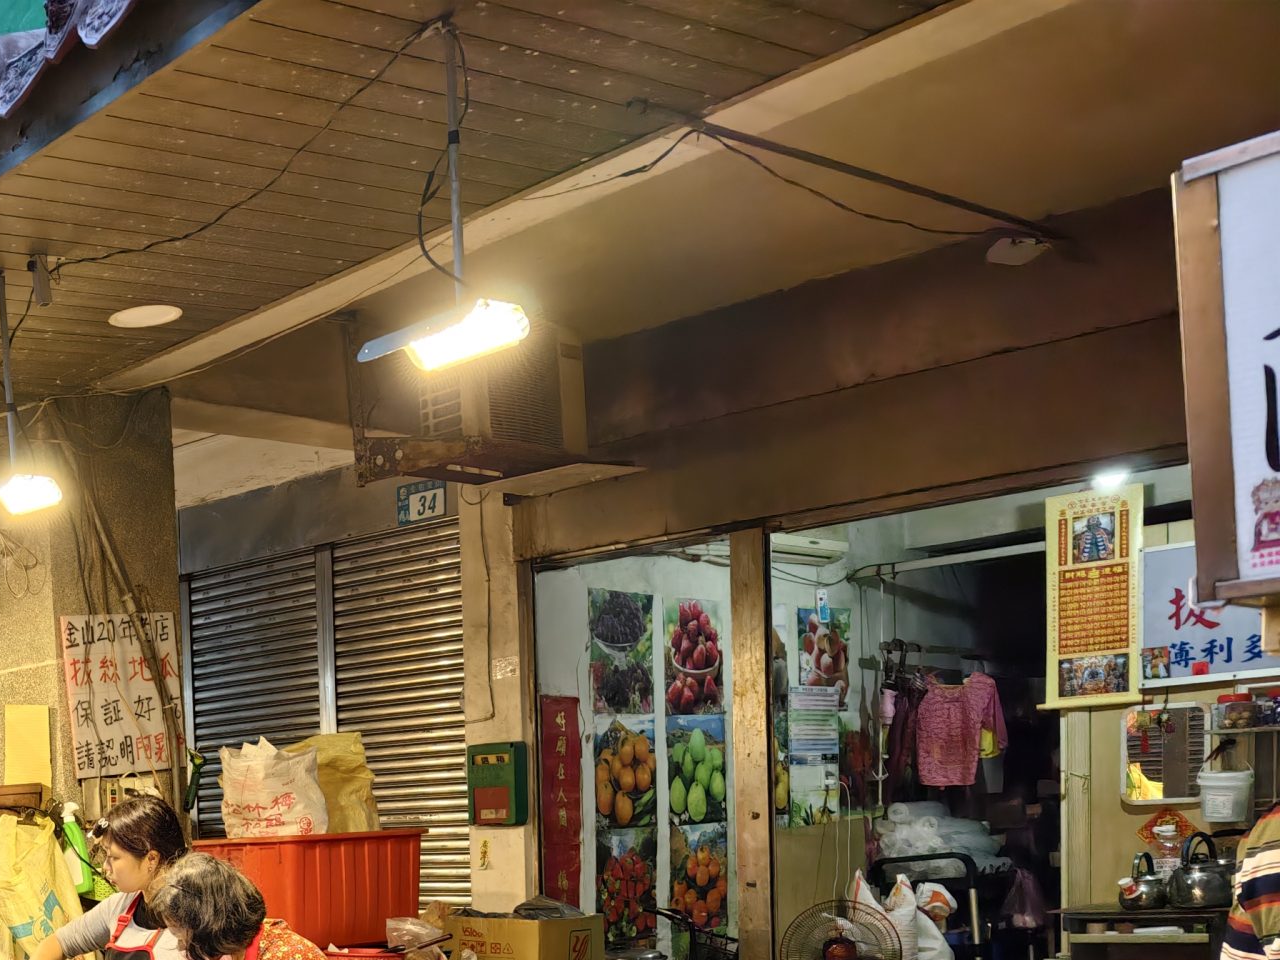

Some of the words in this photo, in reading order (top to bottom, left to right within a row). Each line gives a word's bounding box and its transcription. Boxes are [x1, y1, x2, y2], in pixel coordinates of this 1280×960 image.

[417, 492, 437, 516] 34
[75, 732, 185, 772] 請認明阿晃
